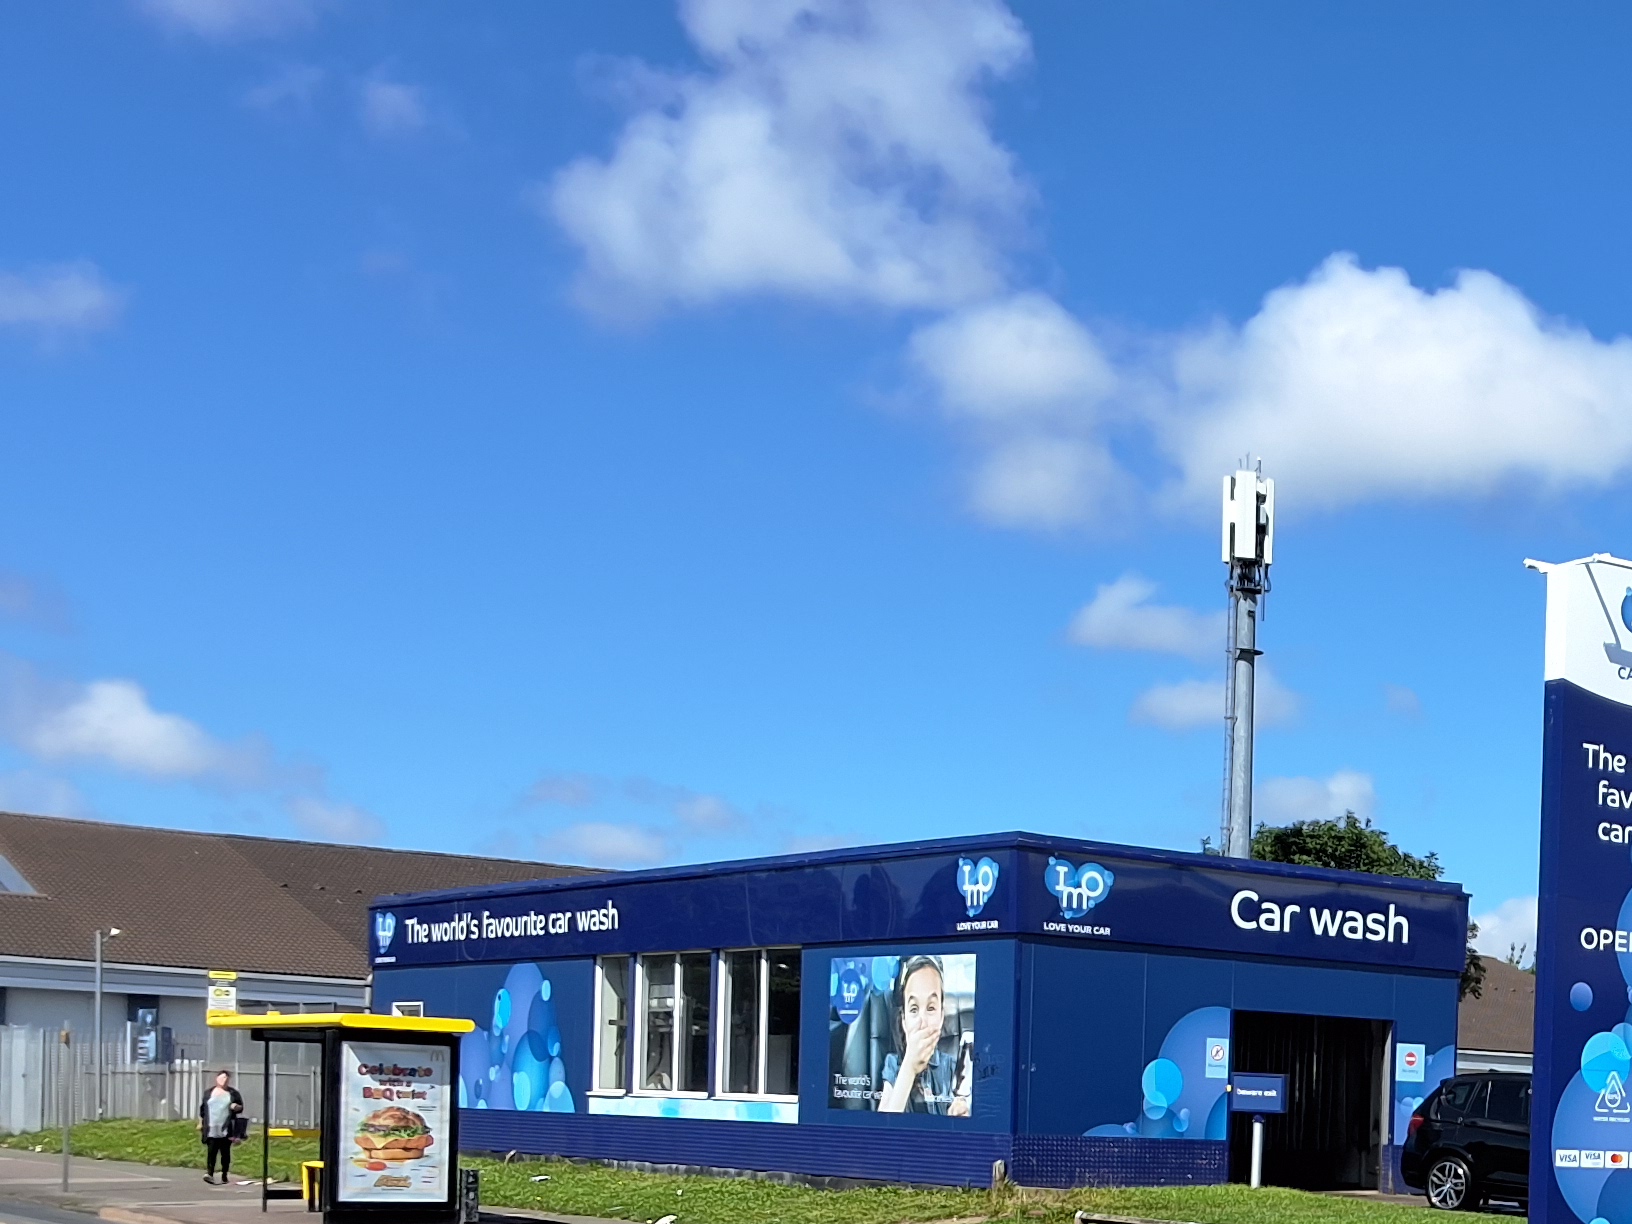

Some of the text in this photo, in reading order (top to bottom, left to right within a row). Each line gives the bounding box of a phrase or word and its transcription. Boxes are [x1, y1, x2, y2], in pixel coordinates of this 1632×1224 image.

[1583, 743, 1626, 774] The
[404, 899, 619, 944] The world's favourite car wash
[1230, 889, 1409, 944] Car wash
[1043, 921, 1111, 936] LOVE YOUR CAR
[1559, 1153, 1577, 1163] VISA
[1585, 1152, 1601, 1160] VISA
